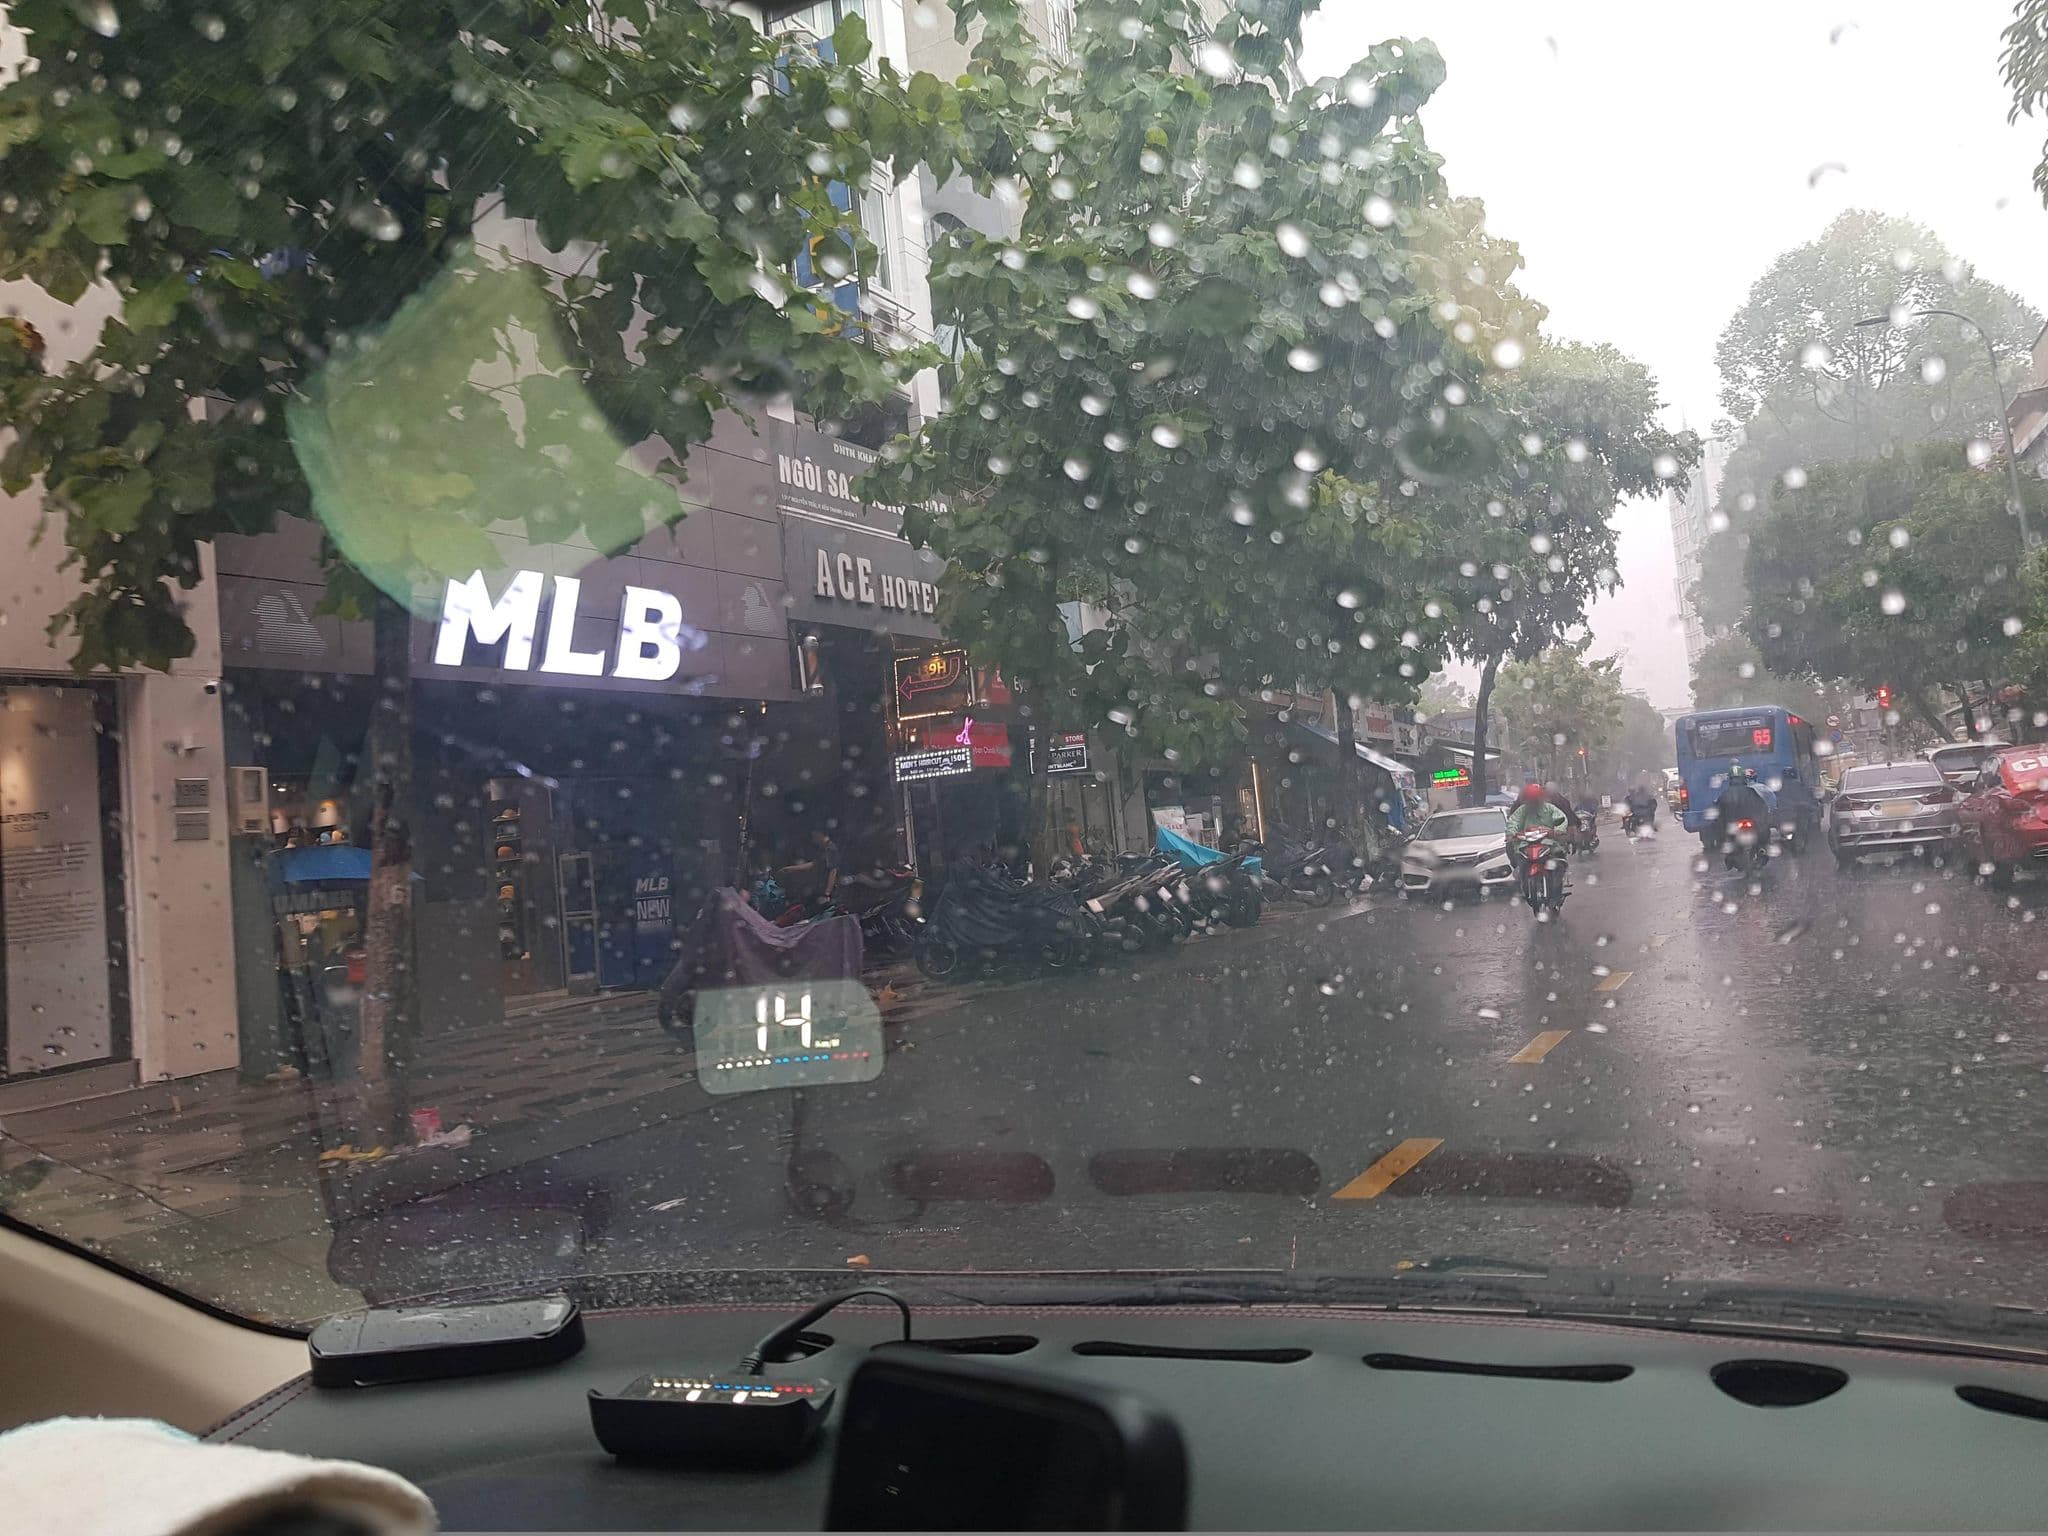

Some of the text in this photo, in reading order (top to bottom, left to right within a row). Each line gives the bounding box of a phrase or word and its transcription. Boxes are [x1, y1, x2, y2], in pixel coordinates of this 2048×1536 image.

[833, 443, 857, 459] DNTN
[778, 454, 822, 493] NGÔI
[816, 549, 875, 604] ACE
[434, 569, 683, 681] MLB
[1065, 734, 1084, 743] STORE
[1753, 728, 1771, 746] 65
[1051, 750, 1083, 760] PARKER
[636, 877, 669, 893] MLB
[637, 899, 670, 920] NEW
[756, 991, 812, 1052] 14
